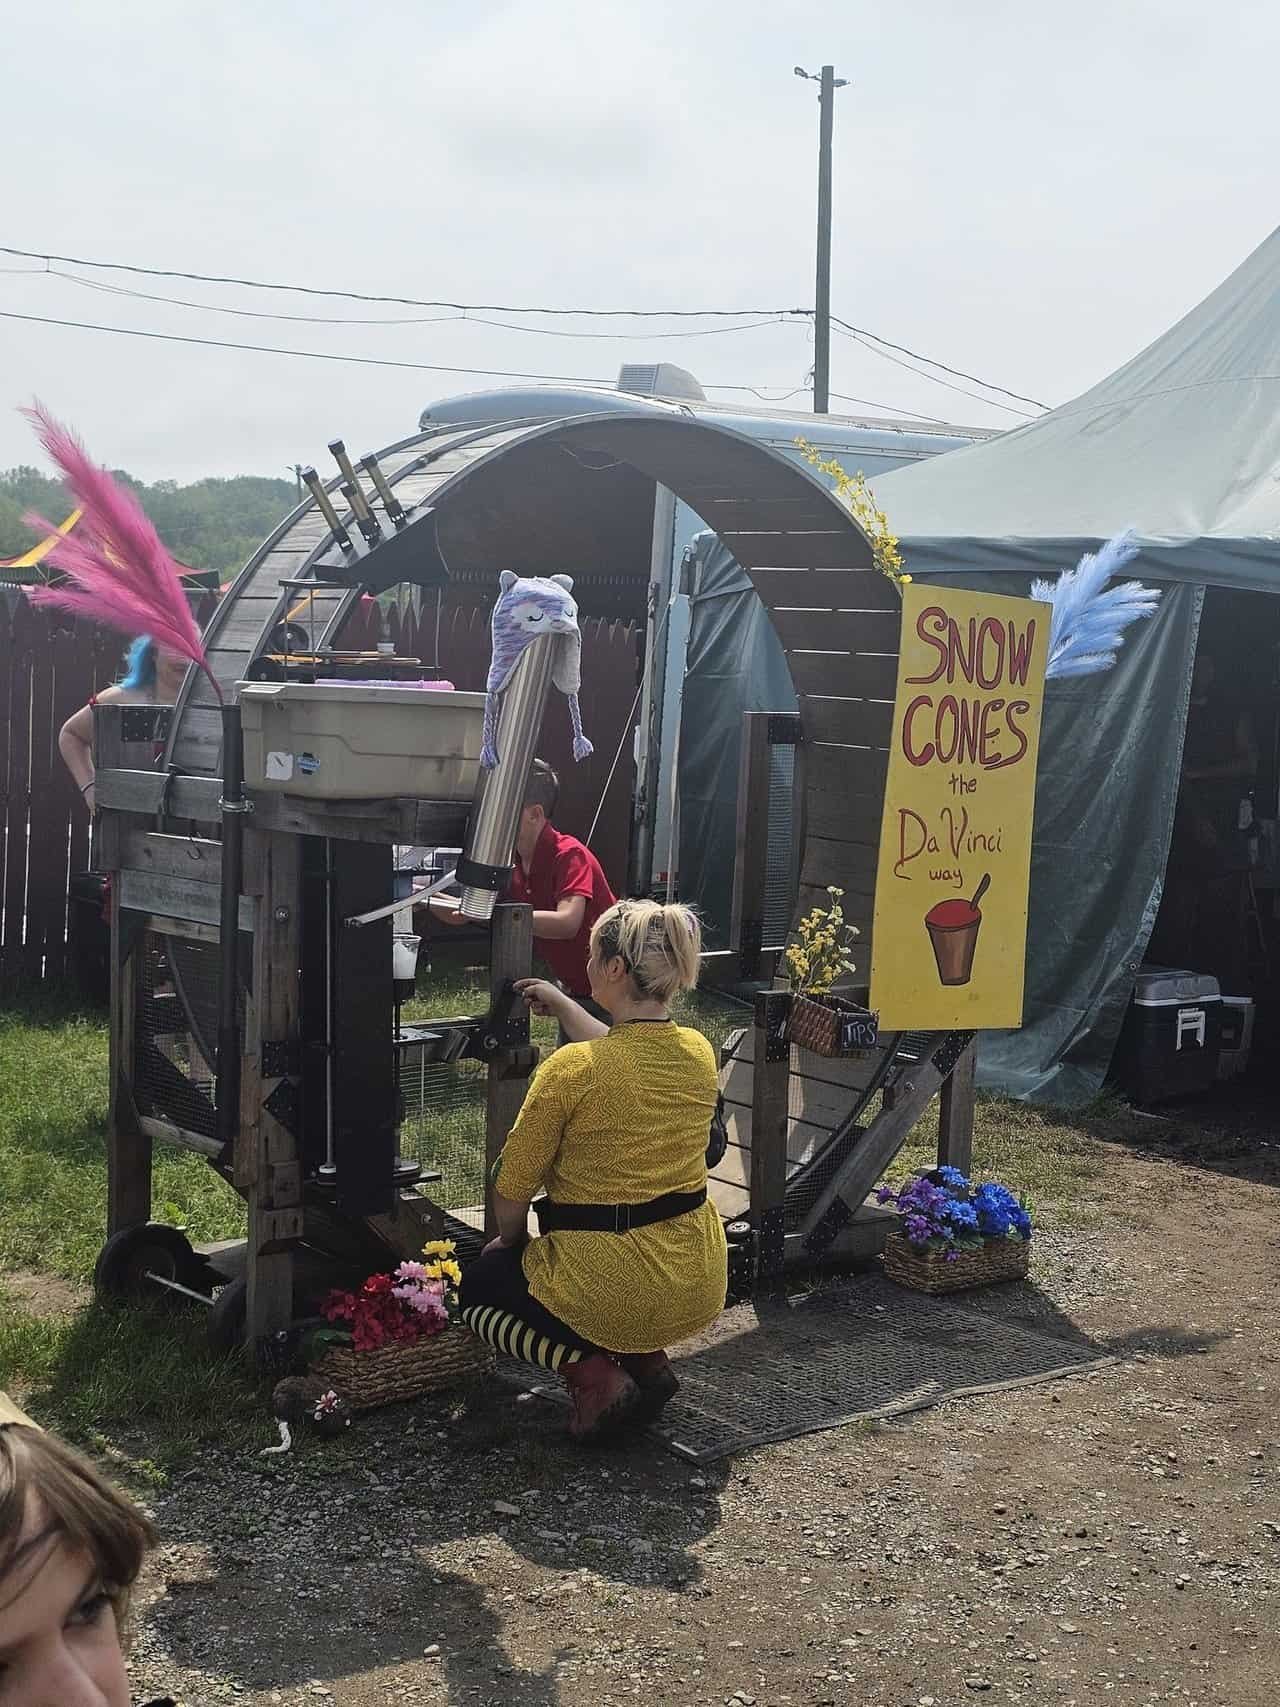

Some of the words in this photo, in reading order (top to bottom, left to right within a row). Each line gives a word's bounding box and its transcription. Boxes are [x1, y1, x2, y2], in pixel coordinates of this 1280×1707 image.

[904, 606, 1036, 690] SNOW
[902, 694, 1030, 771] CONES
[949, 772, 978, 795] the
[893, 807, 940, 880] Da
[940, 806, 1003, 860] Vinci
[928, 867, 964, 889] way
[843, 1020, 877, 1045] TIPS
